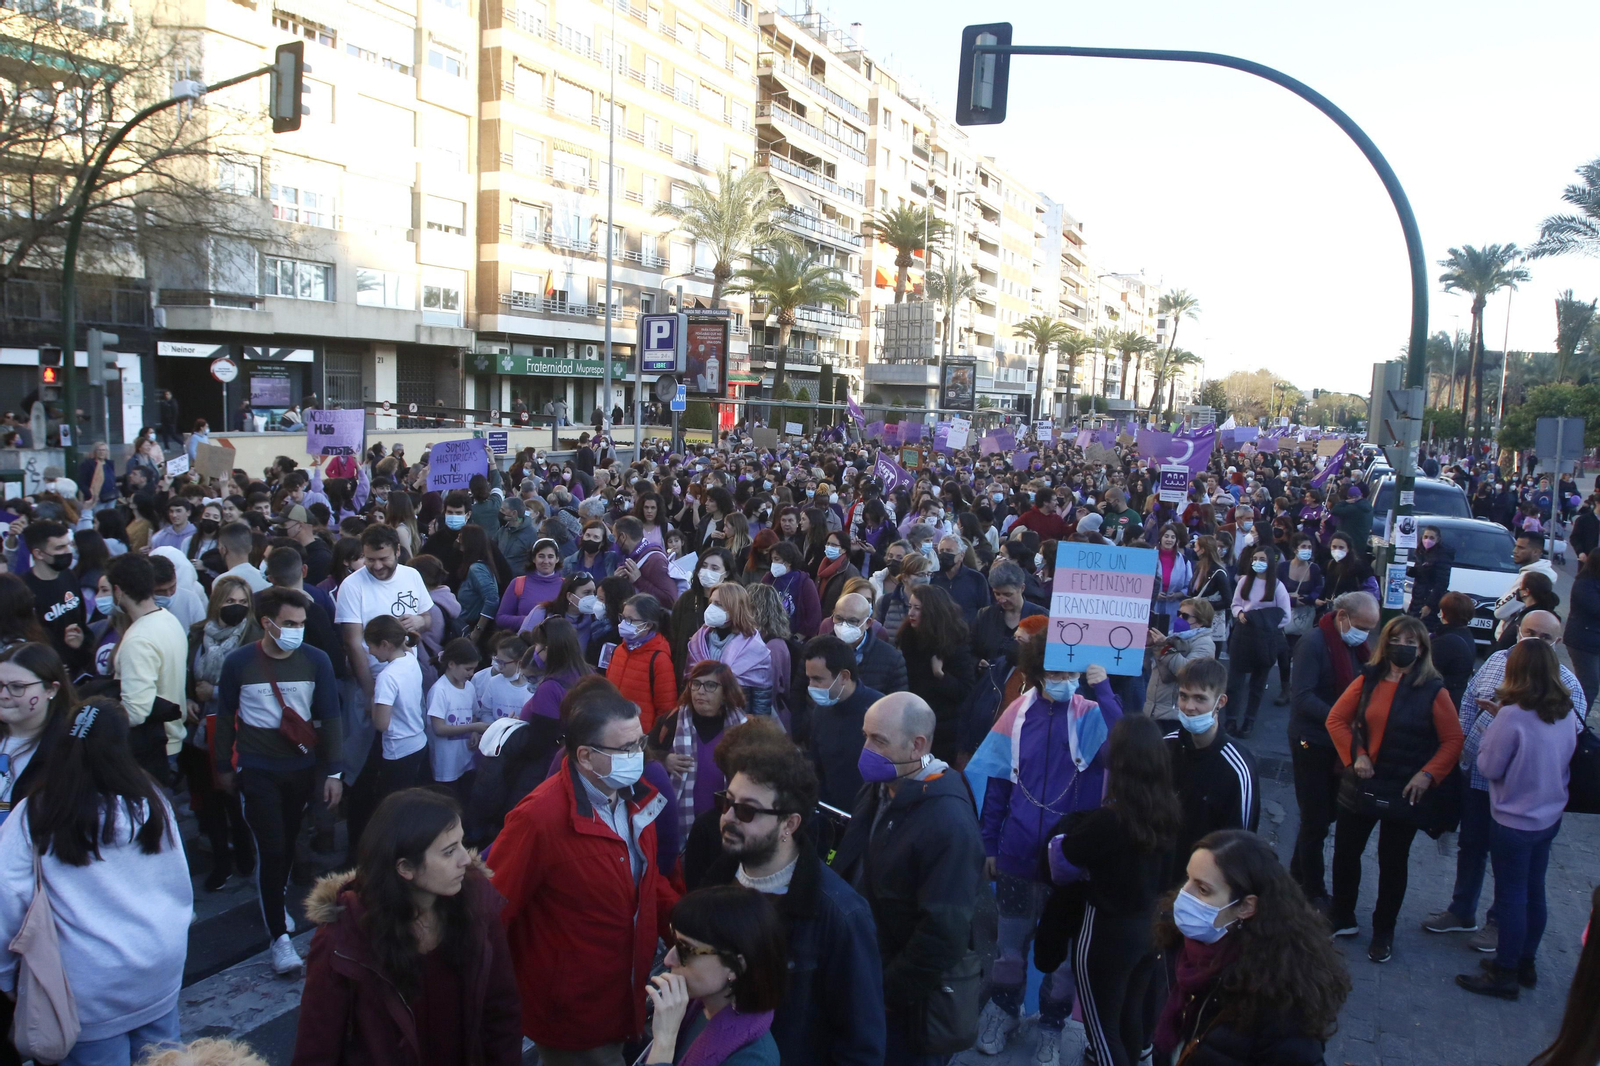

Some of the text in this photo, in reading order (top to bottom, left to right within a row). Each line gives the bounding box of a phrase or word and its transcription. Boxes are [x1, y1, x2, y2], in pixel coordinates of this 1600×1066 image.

[650, 321, 670, 349] P
[171, 345, 196, 353] Neinor
[526, 358, 573, 374] Fraternidad
[445, 441, 470, 453] SOMOS
[450, 463, 461, 473] NO
[1078, 550, 1127, 570] POR UN
[1071, 572, 1142, 594] FEMINISMO
[1057, 595, 1149, 621] TRANSINCLUSIVO
[1474, 619, 1491, 628] JNS
[257, 686, 297, 694] NEVMIND
